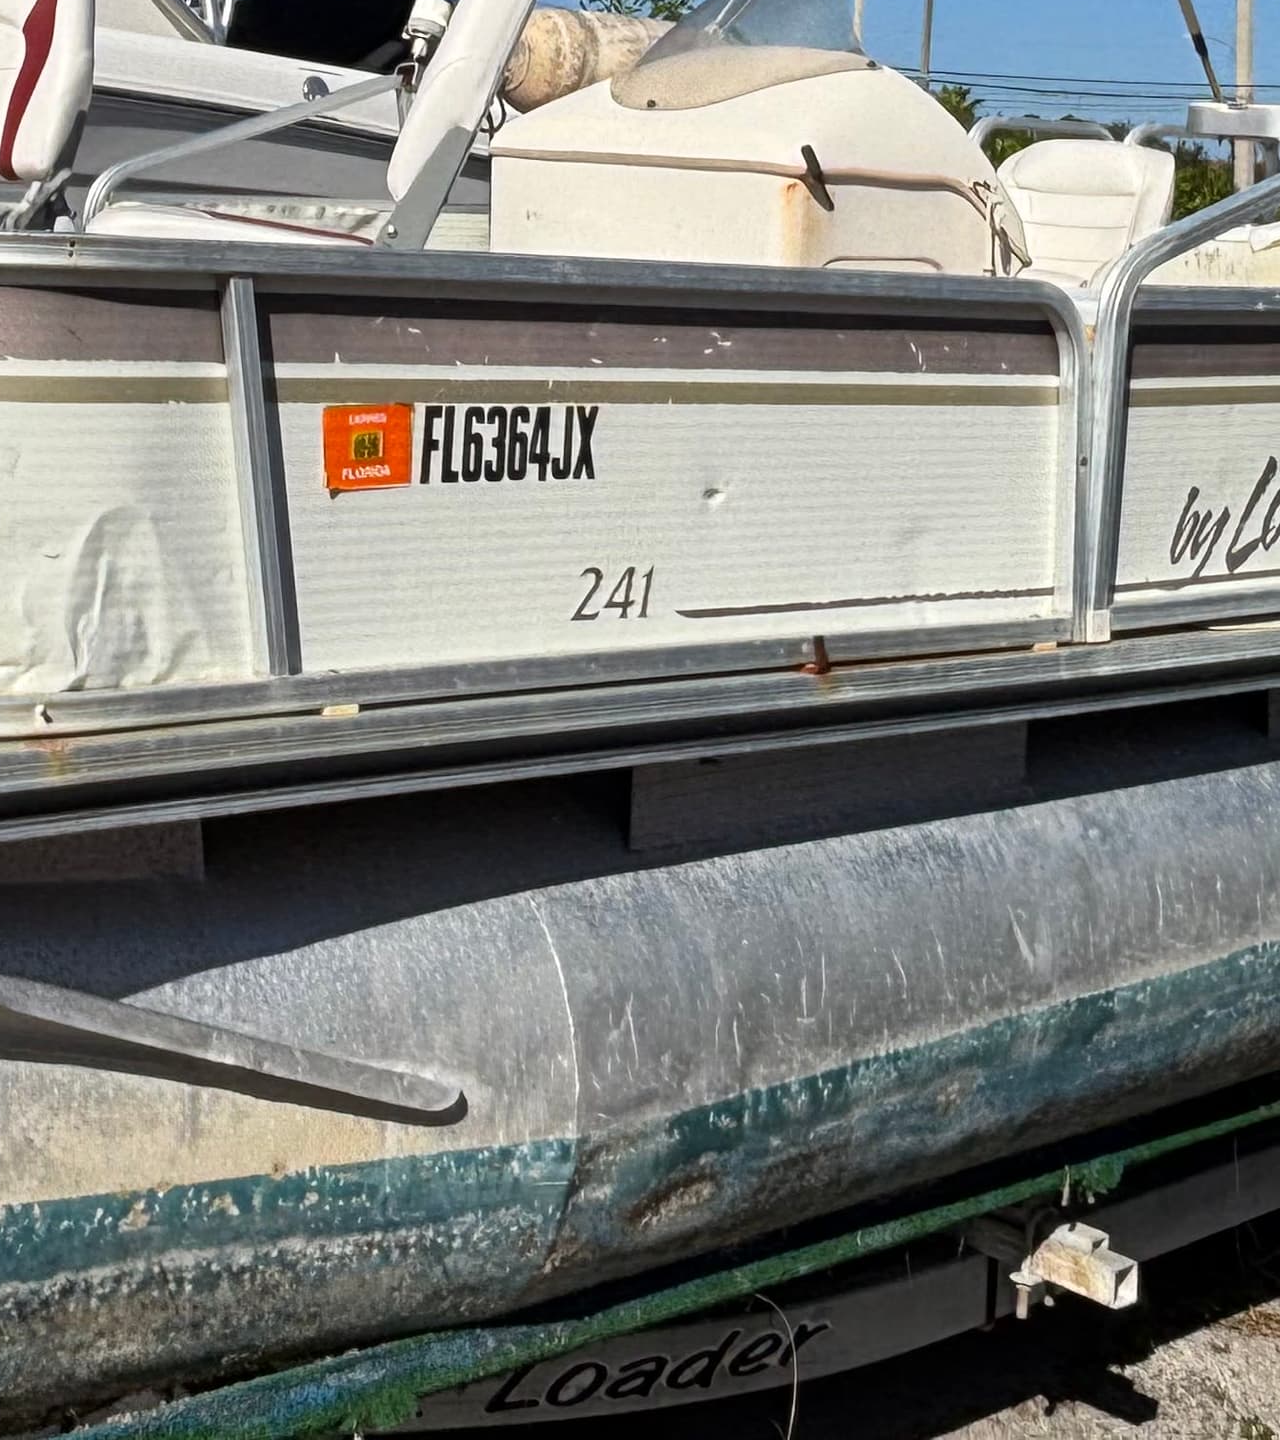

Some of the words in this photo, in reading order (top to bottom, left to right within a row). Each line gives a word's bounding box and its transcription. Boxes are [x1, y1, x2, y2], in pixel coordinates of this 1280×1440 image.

[419, 405, 599, 484] FL6364JX
[1170, 486, 1231, 579] by
[570, 564, 655, 622] 241
[484, 1320, 832, 1414] Loader
